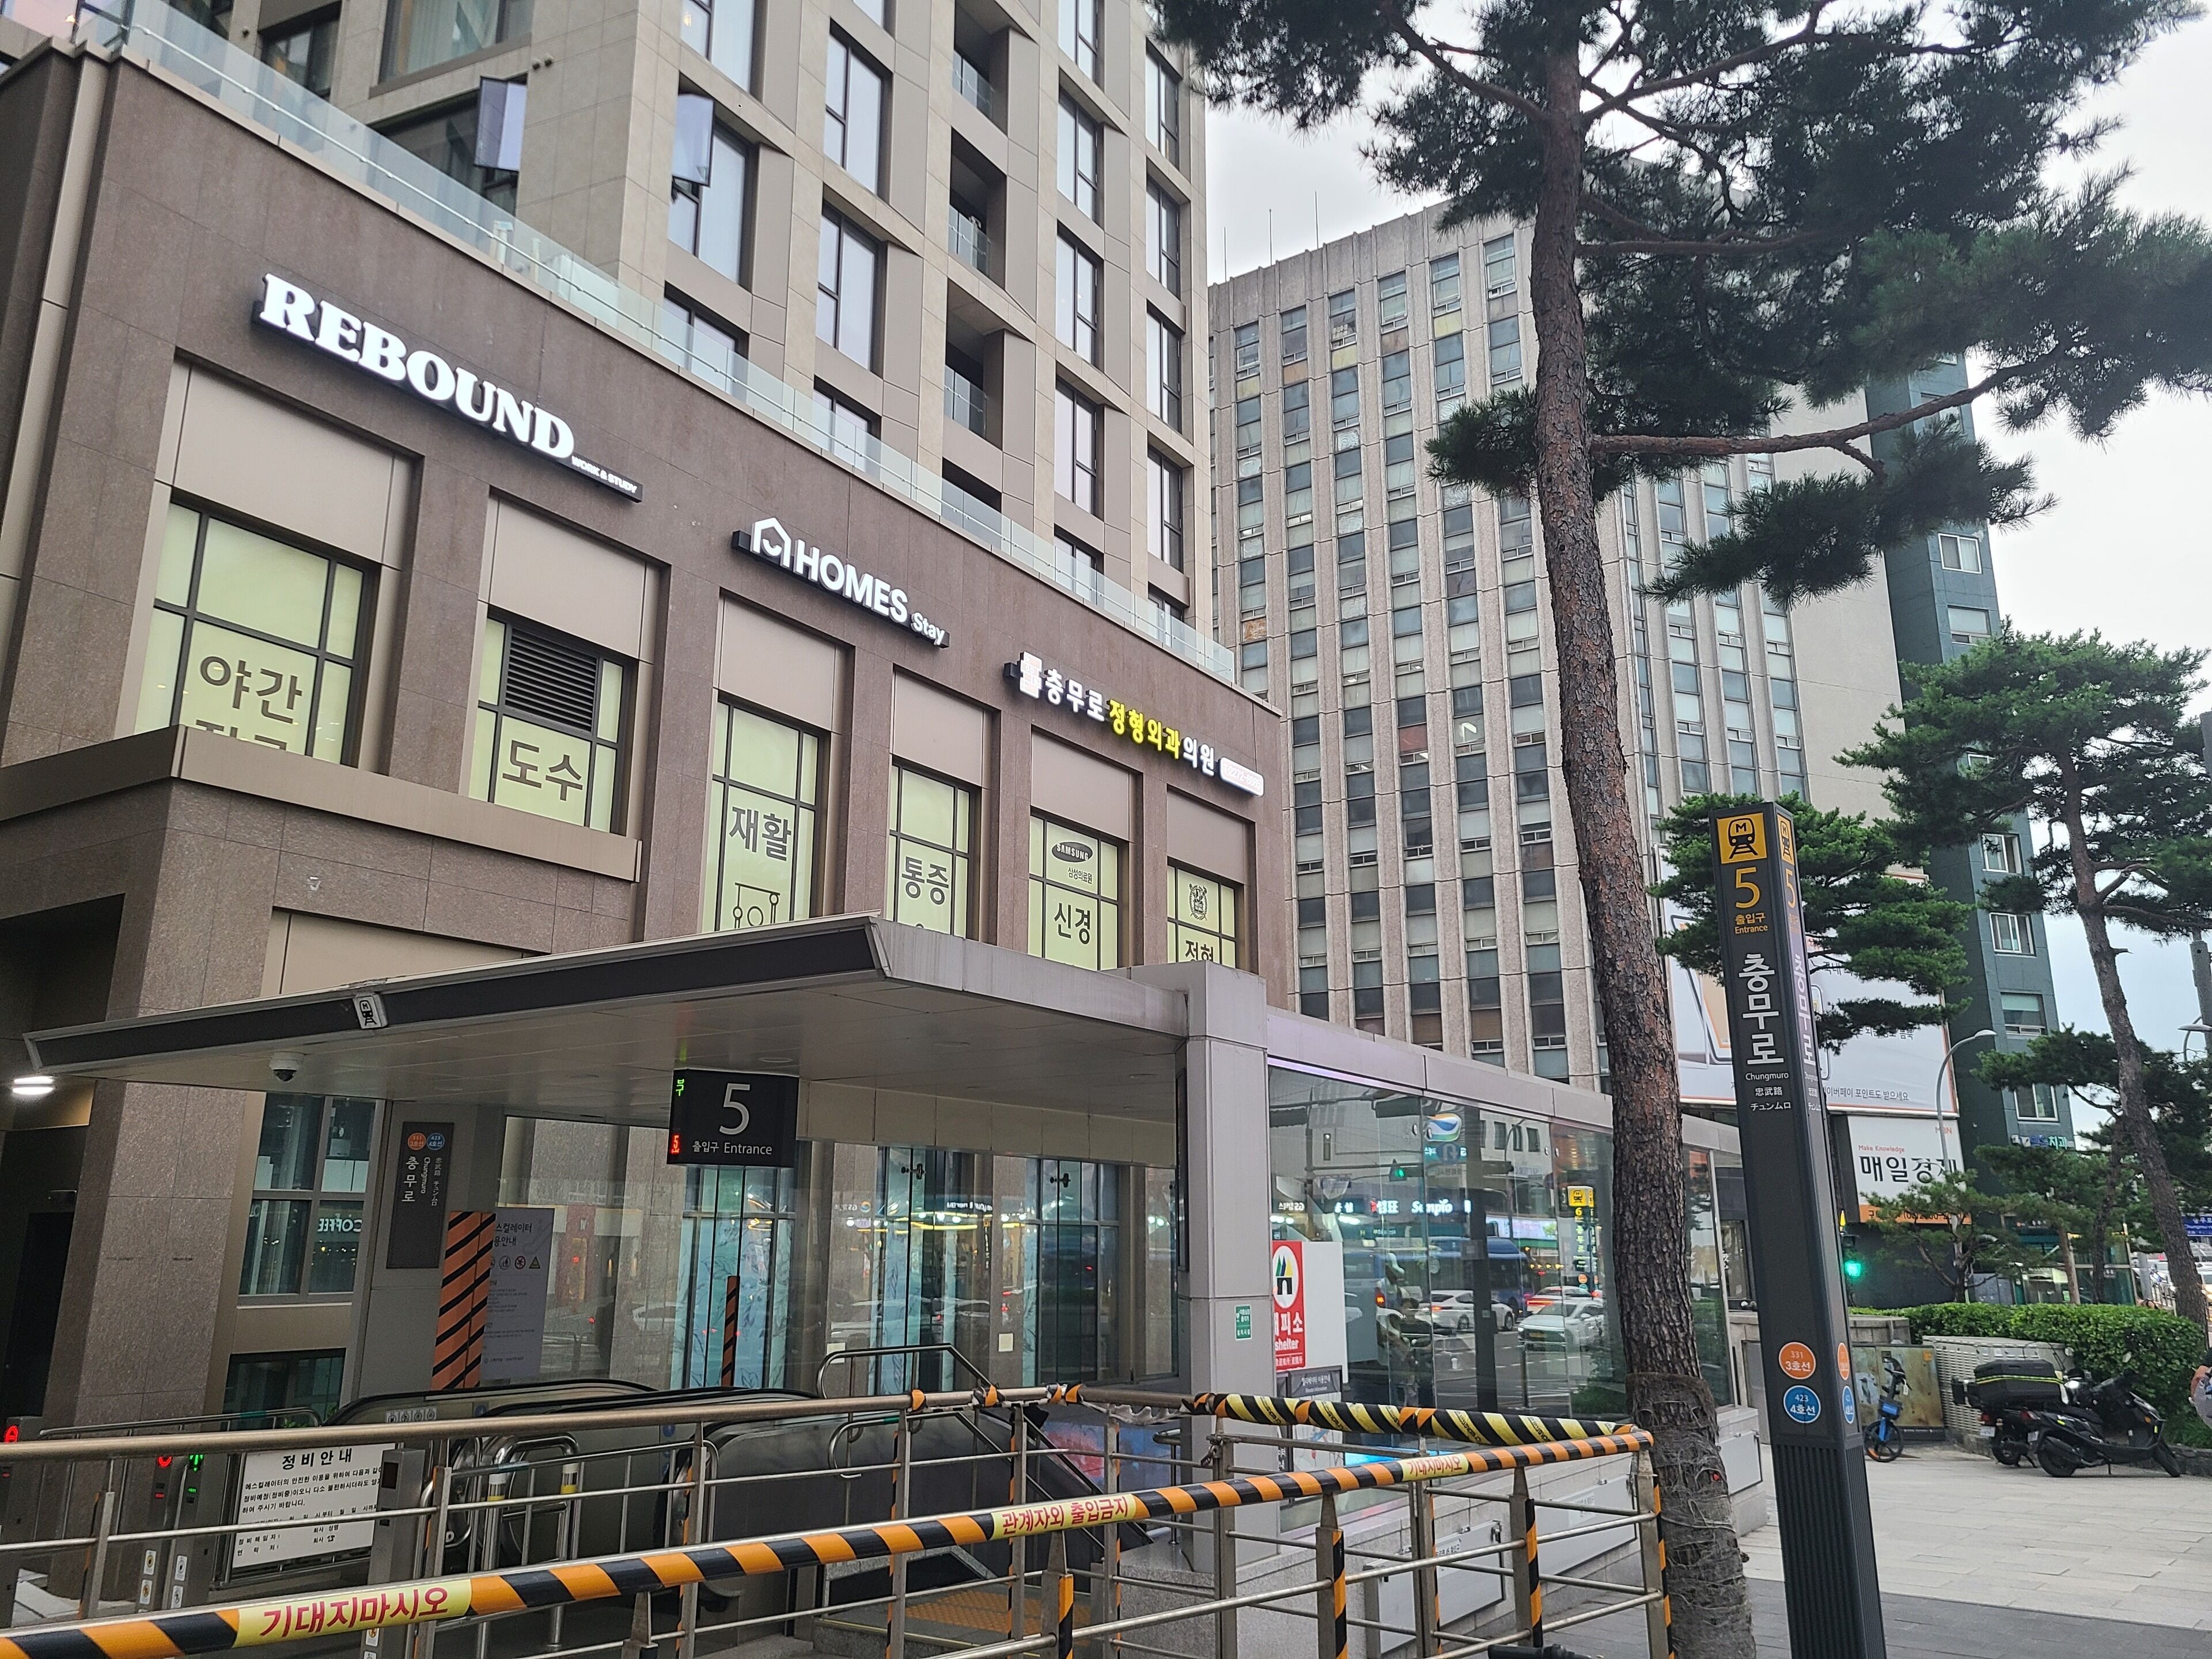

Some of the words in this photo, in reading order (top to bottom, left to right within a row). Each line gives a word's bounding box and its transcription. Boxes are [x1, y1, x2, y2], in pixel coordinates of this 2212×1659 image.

[259, 273, 574, 459] REBOUND
[571, 456, 600, 476] WORK
[600, 469, 608, 480] &
[608, 474, 638, 493] STUDY
[794, 539, 908, 623] HOMES
[199, 656, 302, 724] 야간
[503, 740, 583, 801] 도수
[729, 806, 791, 861] 재활
[1057, 843, 1088, 861] SAMSUNG
[902, 856, 949, 906] 통증
[1068, 867, 1092, 884] 삼성의료원
[1735, 867, 1760, 908] 5
[1786, 869, 1796, 908] 5
[1054, 903, 1090, 945] 신경
[1735, 912, 1766, 925] 출입구
[1734, 925, 1768, 934] Entrance
[1738, 953, 1784, 1065] 충무로
[1794, 954, 1816, 1066] 충무로
[1745, 1072, 1789, 1081] Chungmuro
[1755, 1086, 1783, 1097] 忠武路
[1855, 1089, 1881, 1099] 포인트도
[1883, 1090, 1910, 1101] 받으세요
[719, 1083, 751, 1135] 5
[1750, 1101, 1791, 1112] チュンムロ
[692, 1141, 719, 1153] 출입구
[724, 1143, 772, 1154] Entrance
[402, 1156, 419, 1202] 충무로
[421, 1157, 431, 1194] Chungmuro
[495, 1223, 532, 1233] 스컬레이터
[494, 1236, 516, 1247] 용안내
[1785, 1361, 1812, 1372] 3호선
[1790, 1404, 1816, 1415] 4호선
[1406, 1455, 1463, 1476] 기대지마시오
[291, 1476, 310, 1484] 안전한
[312, 1474, 329, 1482] 이용을
[333, 1471, 350, 1479] 위하여
[313, 1485, 325, 1493] 다소
[257, 1503, 276, 1512] 주시기
[1002, 1505, 1065, 1535] 관계자외
[1070, 1497, 1128, 1525] 출입금지
[259, 1587, 448, 1638] 기대지마시오
